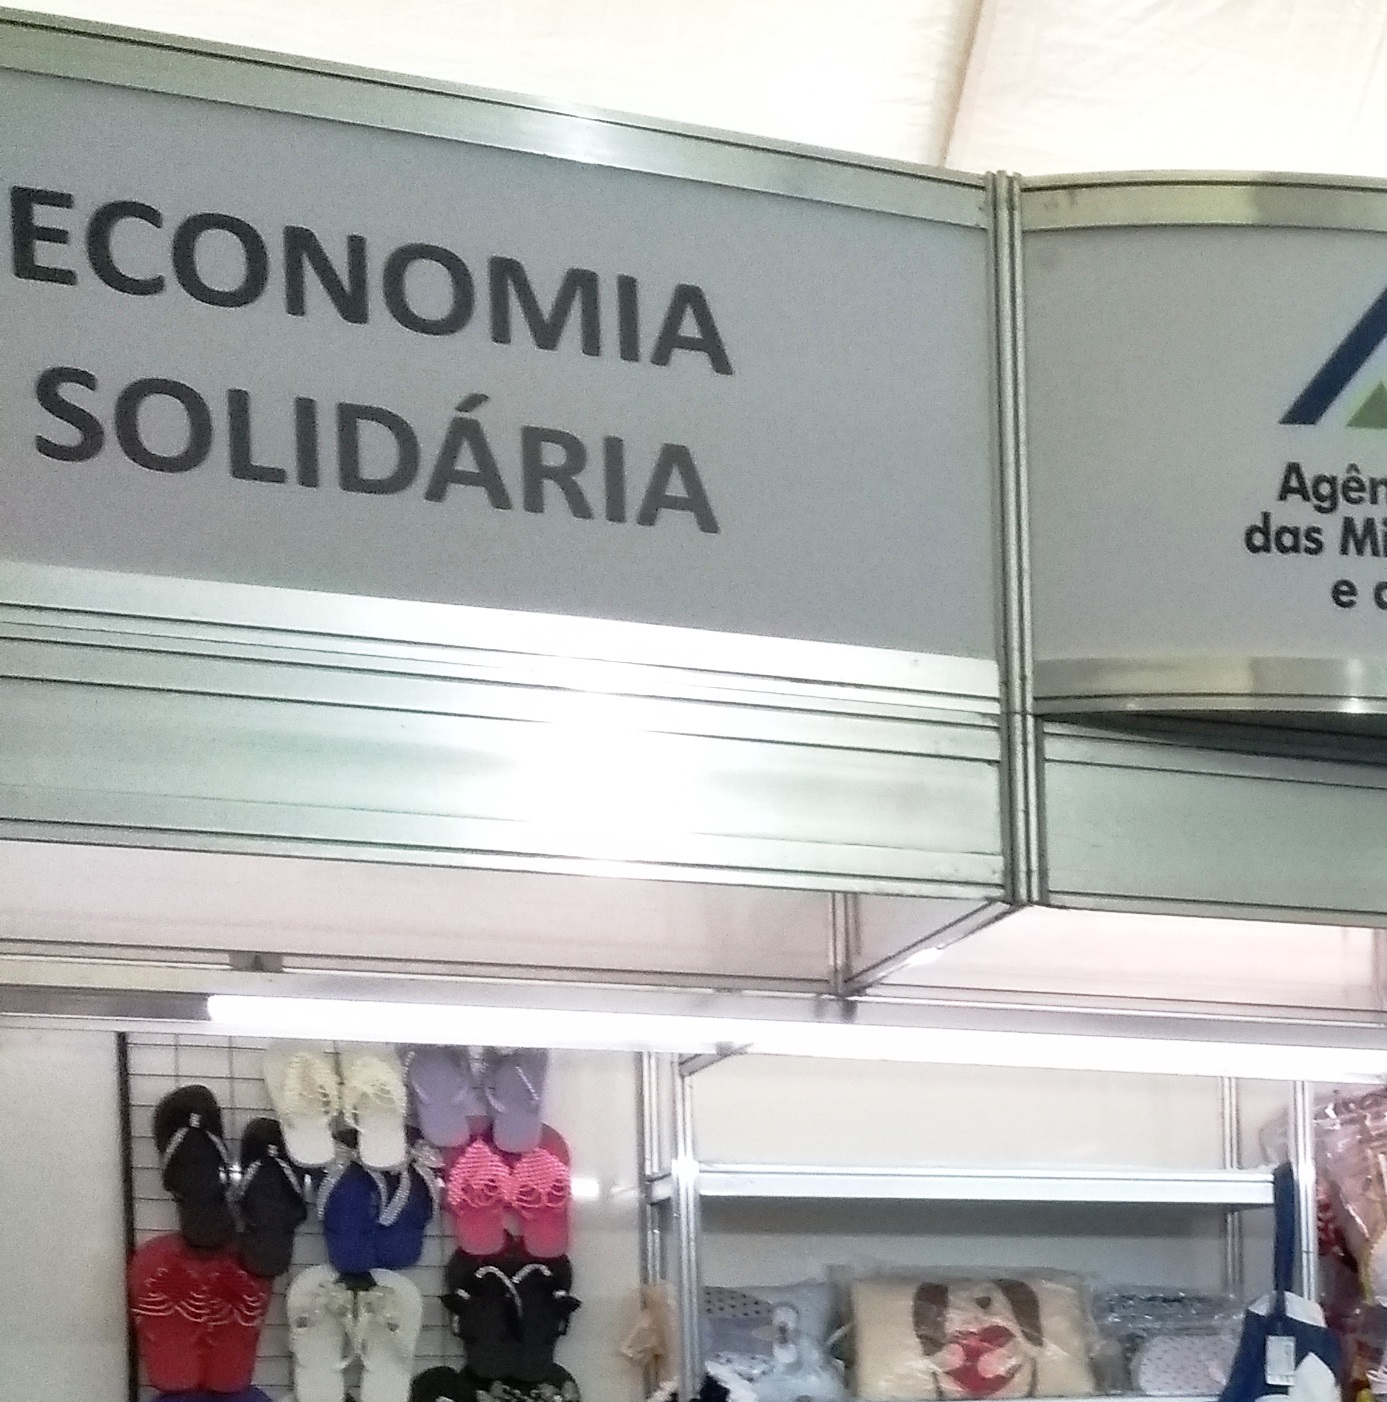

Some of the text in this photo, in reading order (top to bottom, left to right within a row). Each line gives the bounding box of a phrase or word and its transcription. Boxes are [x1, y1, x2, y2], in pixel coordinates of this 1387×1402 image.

[10, 185, 734, 375] ECONOMIA
[35, 366, 720, 535] SOLIDÁRIA
[1245, 511, 1323, 555] das
[1331, 578, 1358, 608] e
